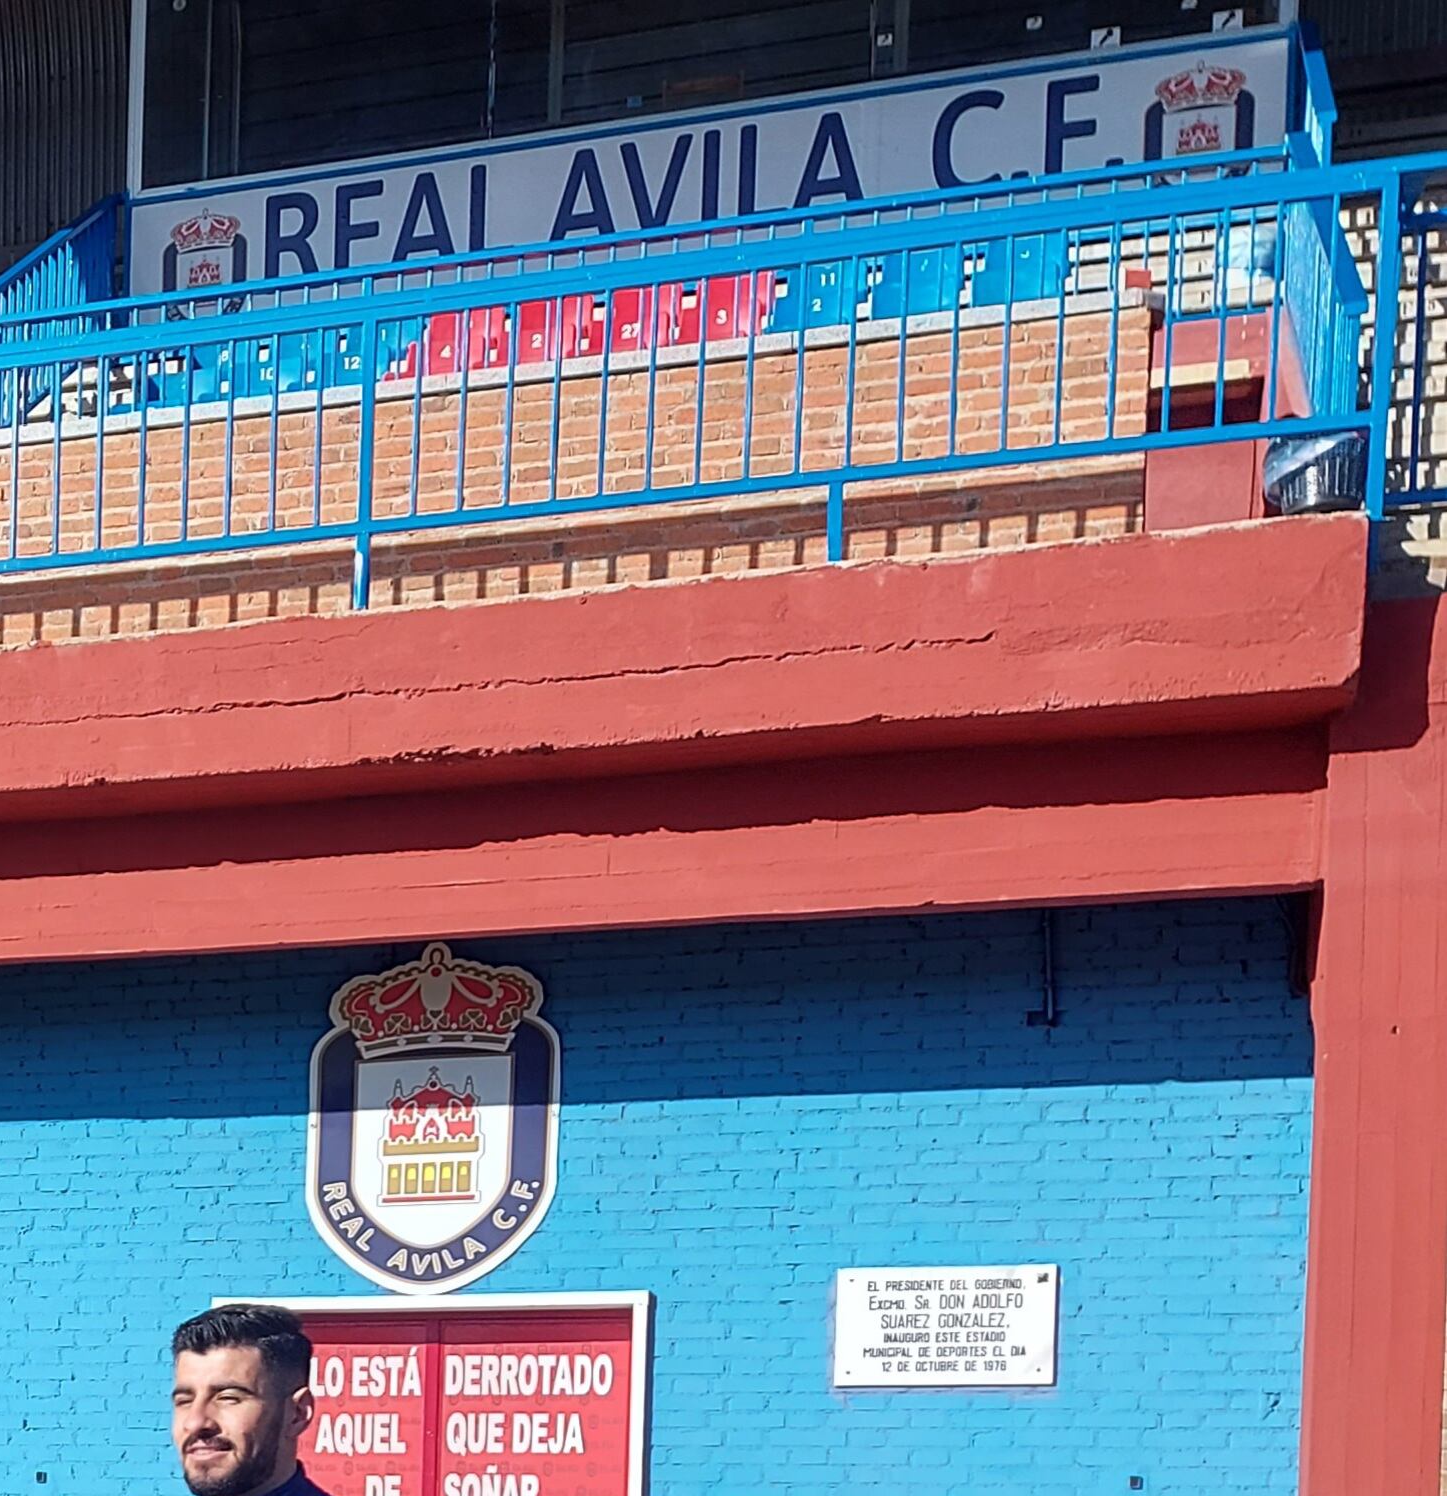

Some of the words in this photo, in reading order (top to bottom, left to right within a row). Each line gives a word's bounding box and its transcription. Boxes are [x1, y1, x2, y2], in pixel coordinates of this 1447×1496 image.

[933, 74, 1124, 187] C.F.
[812, 298, 822, 312] 2
[532, 334, 542, 347] 2
[441, 345, 451, 358] 4
[344, 356, 360, 370] 12
[323, 1181, 374, 1251] REAL
[387, 1236, 487, 1275] AVILA
[867, 1281, 880, 1292] EL
[885, 1280, 945, 1291] PRESIDENTE
[950, 1280, 968, 1290] DEL
[939, 1294, 965, 1309] DON
[972, 1293, 1023, 1308] ADOLFO
[881, 1314, 930, 1329] SUAREZ
[883, 1332, 930, 1343] INAUGURO
[935, 1332, 959, 1343] ESTE
[966, 1331, 1006, 1342] ESTADIO
[863, 1347, 913, 1358] MUNICIPAL
[918, 1347, 931, 1357] DE
[936, 1346, 987, 1357] DEPORTES
[992, 1346, 1005, 1356] EL
[1010, 1346, 1026, 1356] DIA
[309, 1356, 345, 1397] LO
[352, 1347, 422, 1397] ESTÁ
[445, 1354, 613, 1396] DERROTADO
[882, 1362, 892, 1372] 12
[897, 1362, 911, 1372] DE
[915, 1361, 959, 1372] OCTUBRE
[964, 1361, 978, 1372] DE
[314, 1413, 407, 1456] AQUEL
[446, 1413, 504, 1456] QUE
[512, 1413, 584, 1454] DEJA
